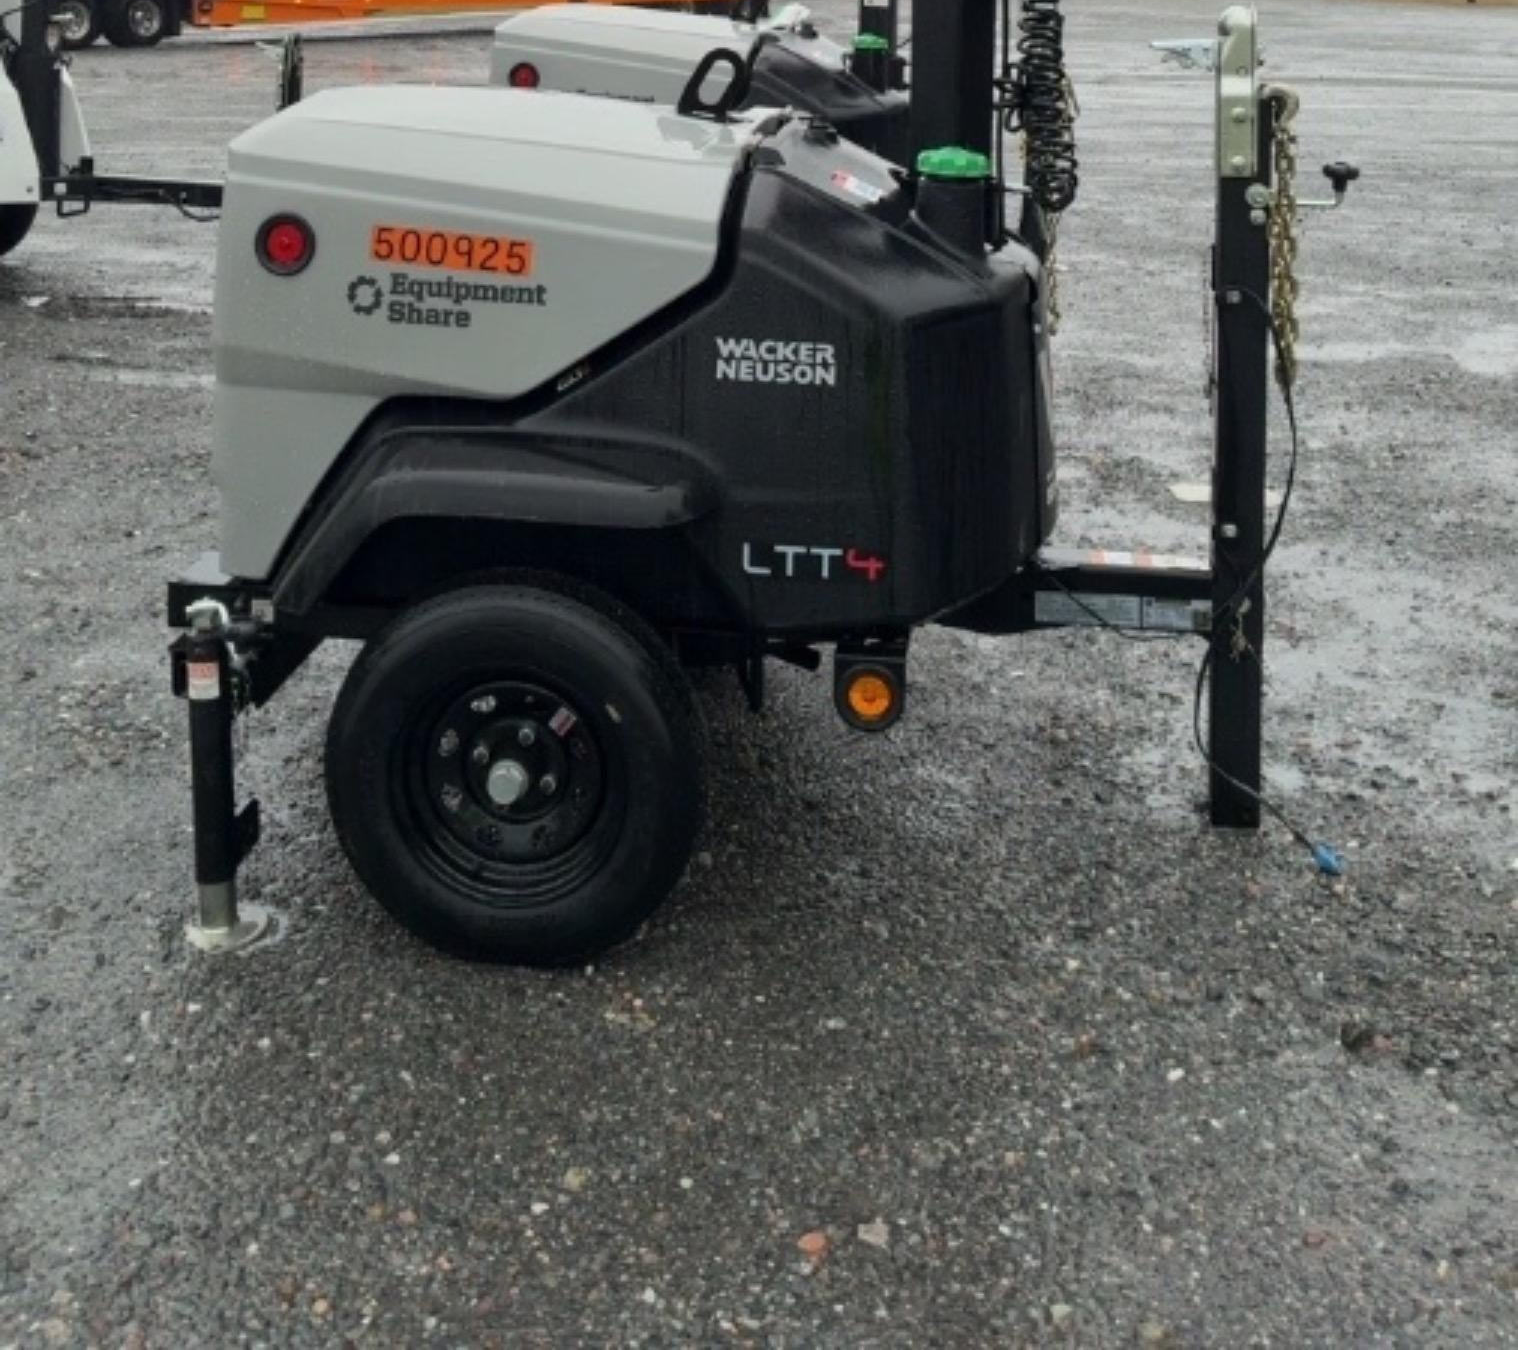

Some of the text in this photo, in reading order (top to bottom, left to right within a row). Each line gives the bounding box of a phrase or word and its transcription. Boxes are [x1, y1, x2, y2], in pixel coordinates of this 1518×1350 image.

[374, 227, 527, 275] 500925
[390, 272, 546, 306] Equipment
[387, 300, 471, 328] Share
[715, 336, 836, 365] WACKER
[716, 358, 836, 386] NEUSON
[743, 541, 885, 581] LTT4
